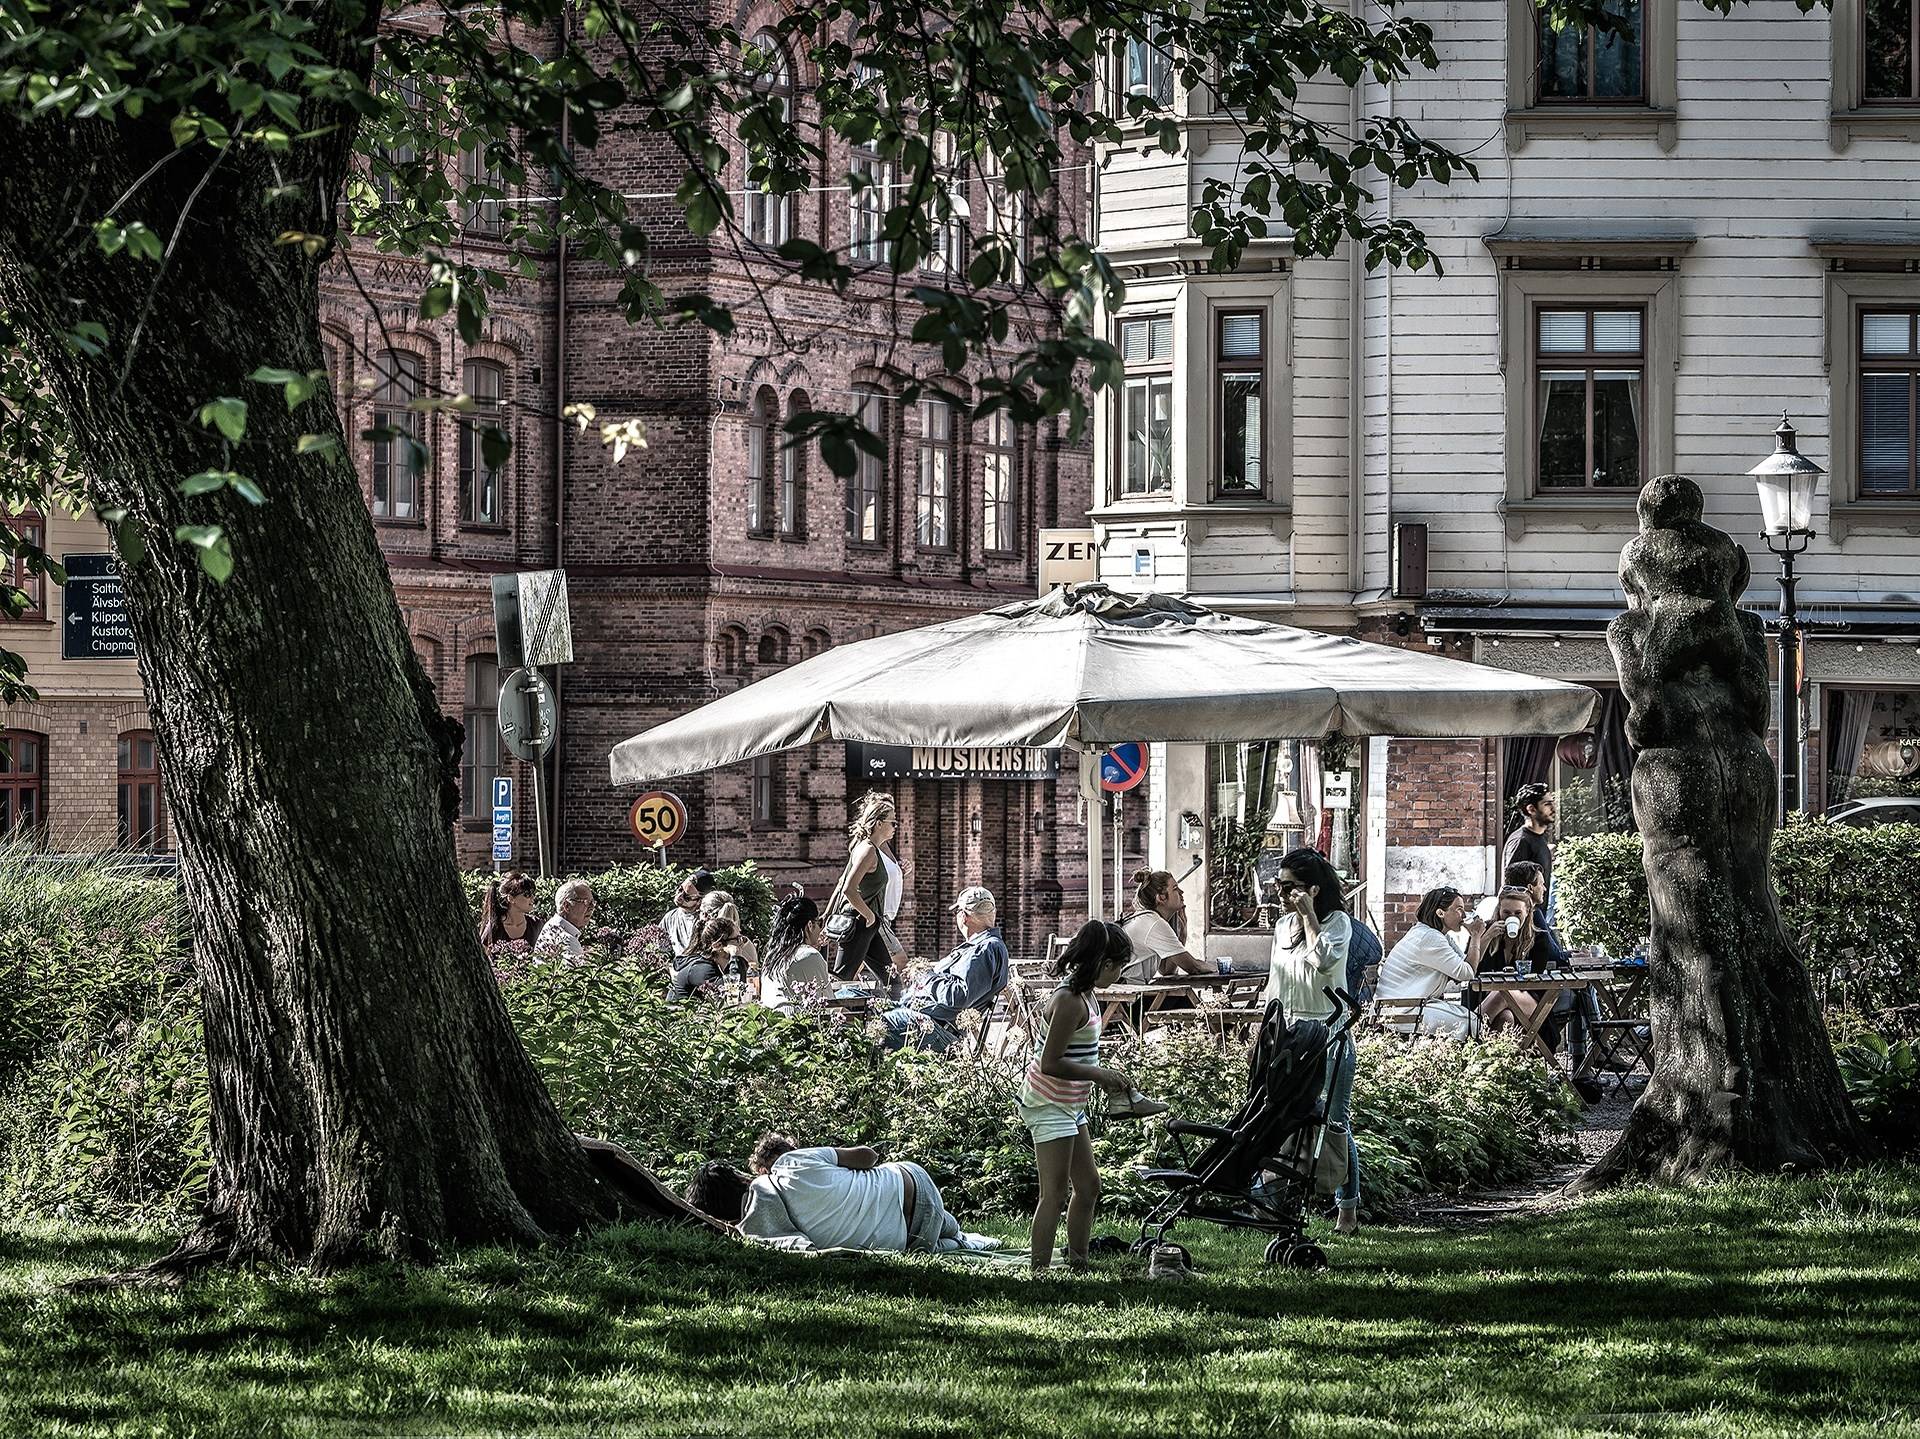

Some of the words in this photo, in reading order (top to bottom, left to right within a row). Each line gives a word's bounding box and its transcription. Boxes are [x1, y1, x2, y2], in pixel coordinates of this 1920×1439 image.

[92, 640, 136, 653] Chapma
[912, 747, 1023, 772] MUSIKENS
[1025, 748, 1048, 772] HUS
[498, 780, 509, 806] P
[640, 805, 676, 834] 50
